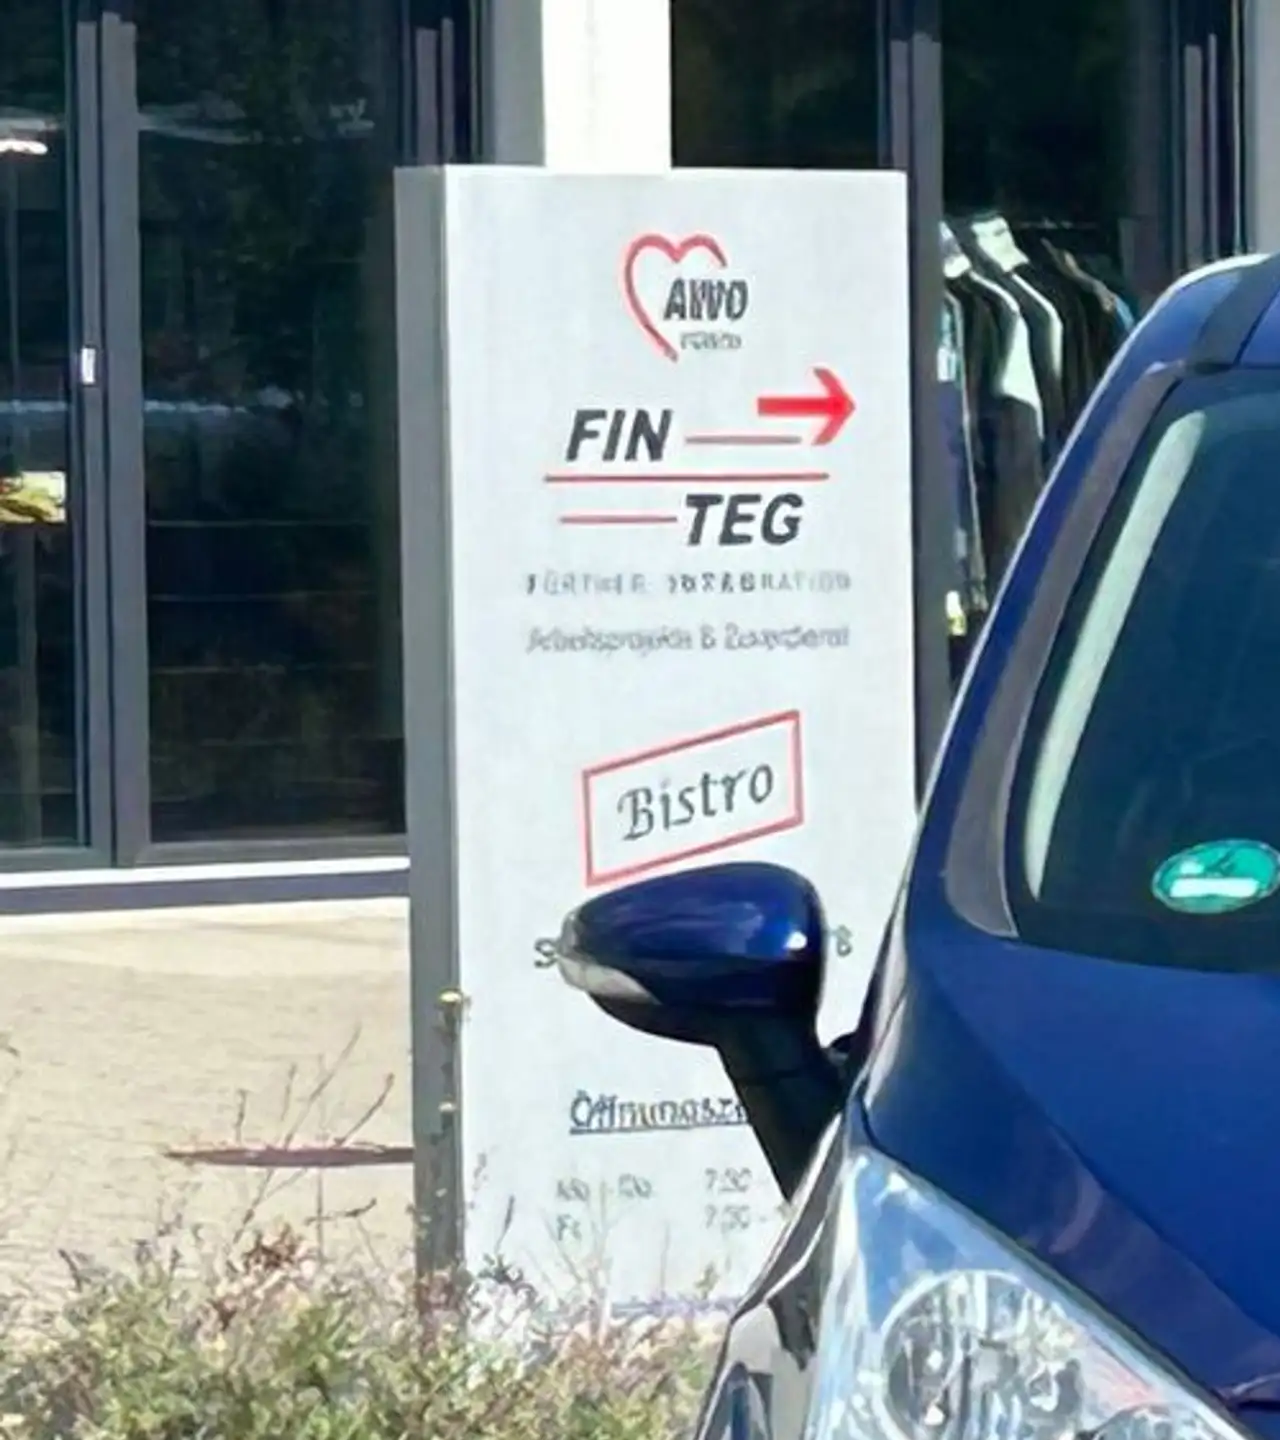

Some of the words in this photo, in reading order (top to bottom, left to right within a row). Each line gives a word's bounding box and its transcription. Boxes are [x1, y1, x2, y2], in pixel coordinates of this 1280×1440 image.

[565, 409, 672, 461] FIN
[685, 494, 804, 546] TEG
[616, 762, 776, 842] Bistro
